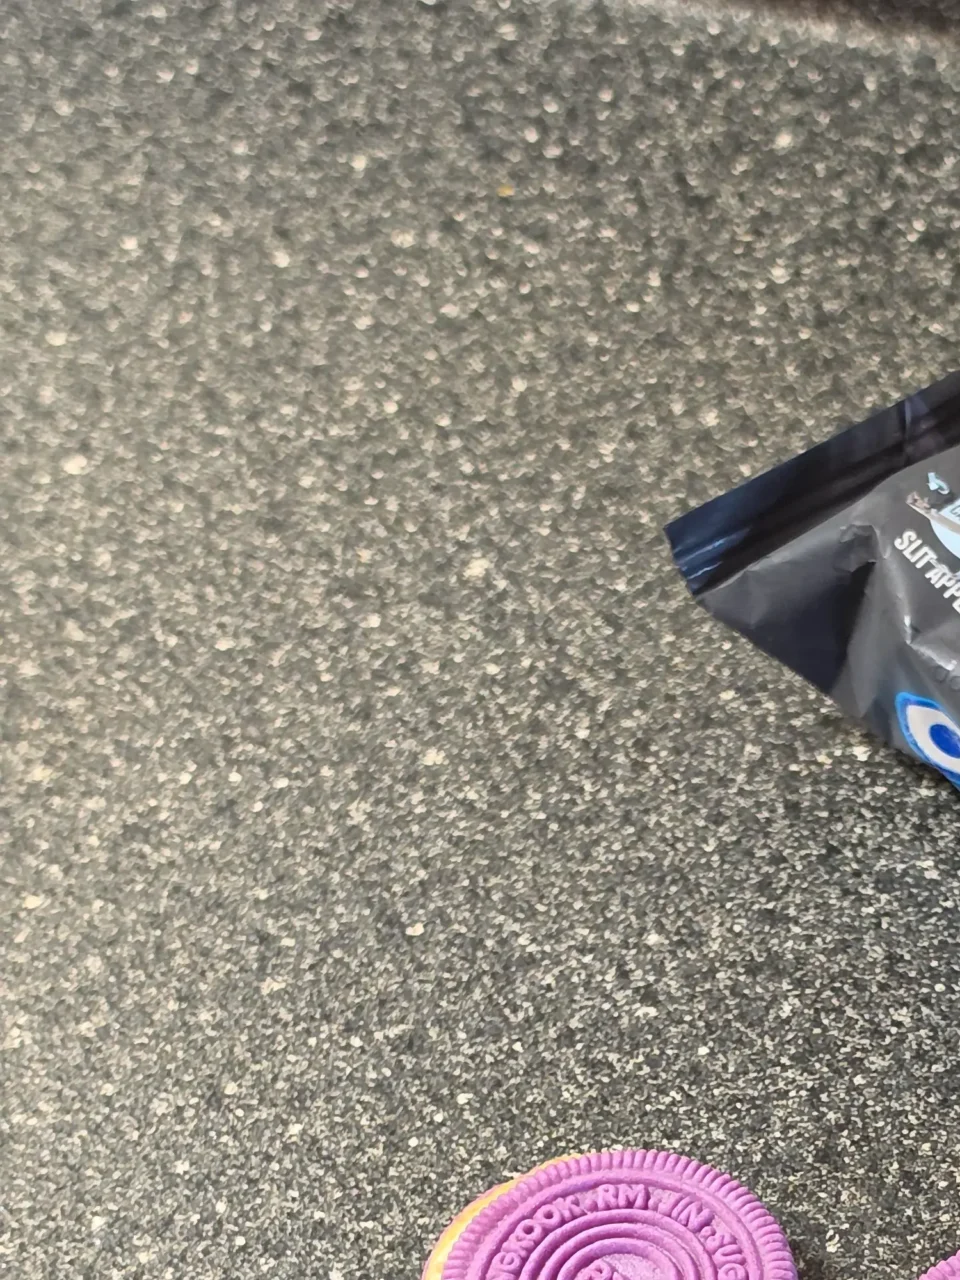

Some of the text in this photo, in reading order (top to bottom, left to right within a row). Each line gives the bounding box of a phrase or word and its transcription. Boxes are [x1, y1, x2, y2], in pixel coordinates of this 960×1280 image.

[893, 530, 938, 569] SLIT
[597, 1184, 649, 1212] RM
[658, 1194, 715, 1233] JIN
